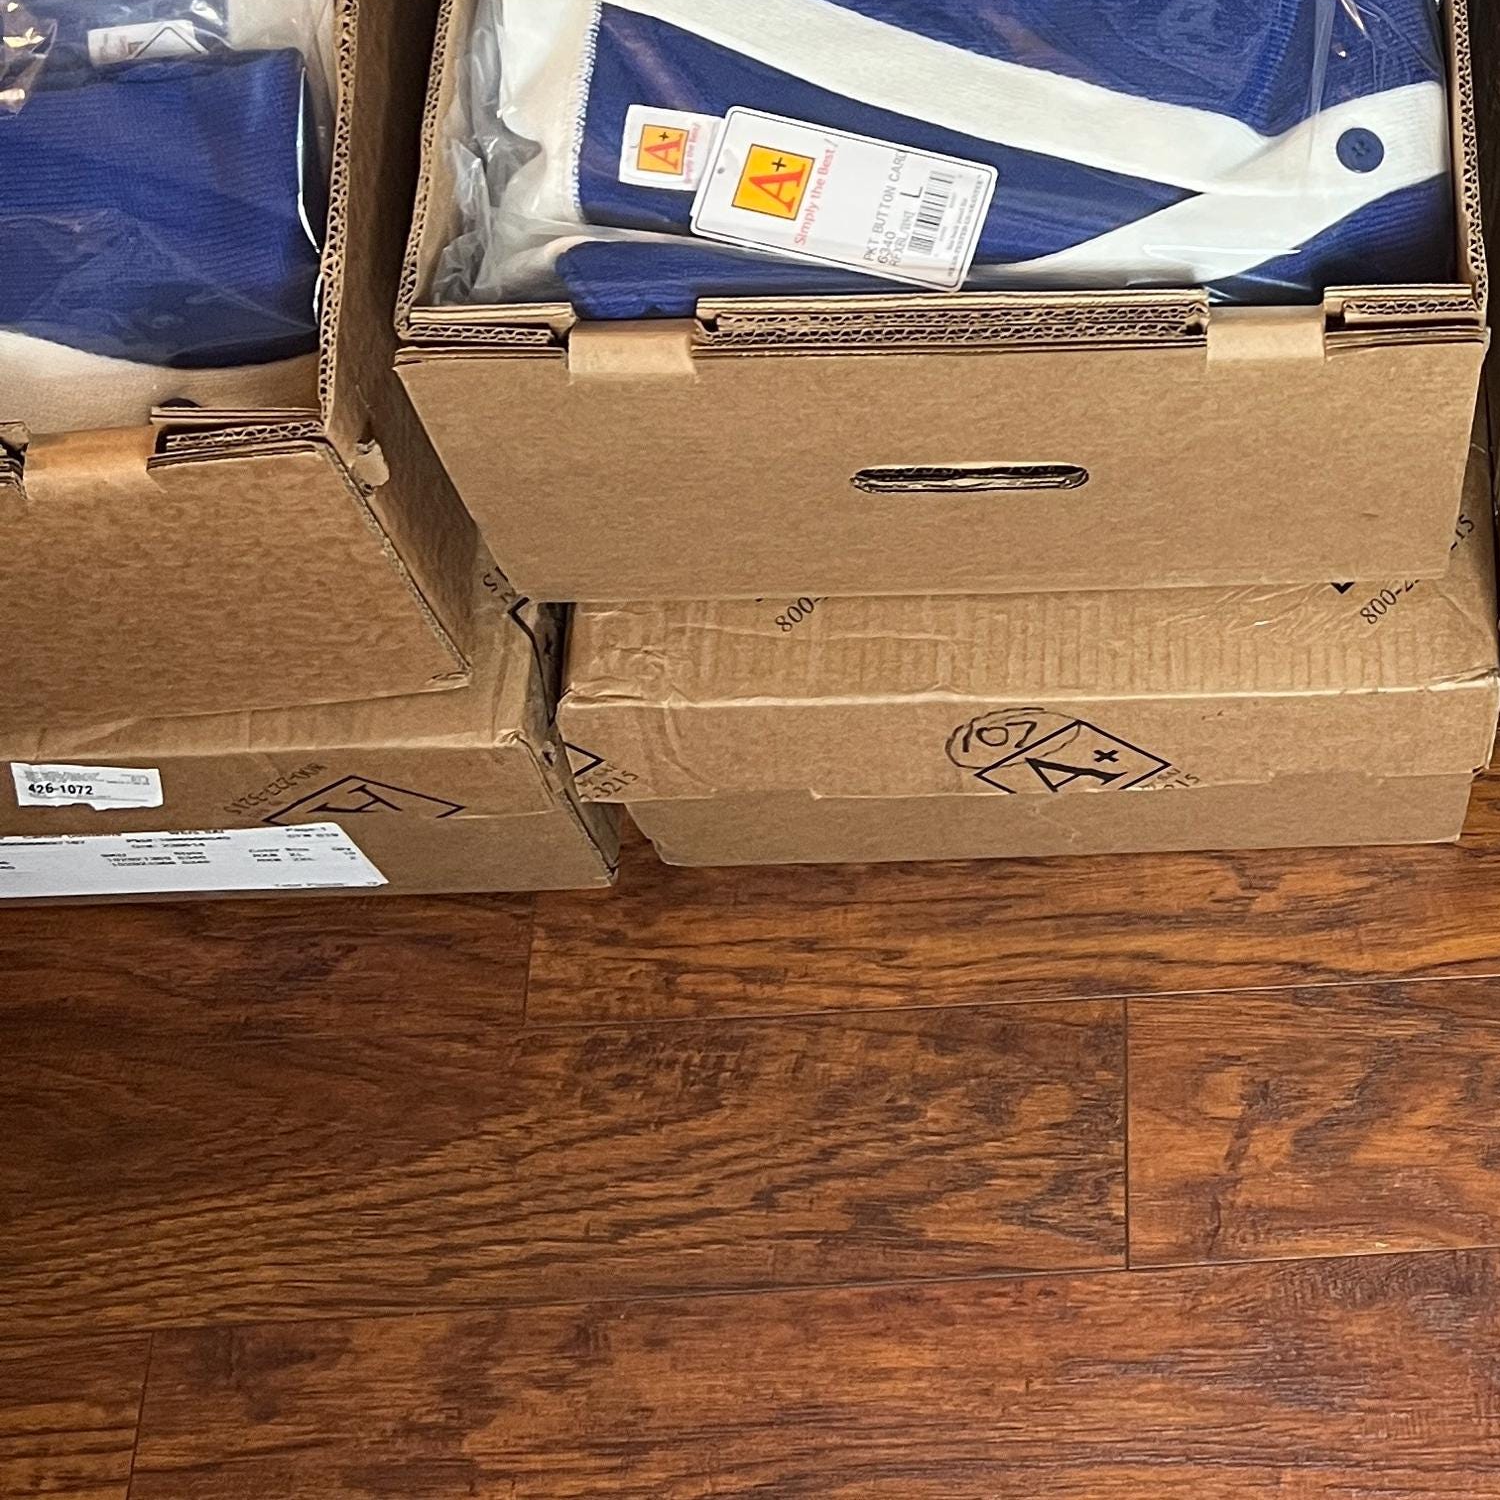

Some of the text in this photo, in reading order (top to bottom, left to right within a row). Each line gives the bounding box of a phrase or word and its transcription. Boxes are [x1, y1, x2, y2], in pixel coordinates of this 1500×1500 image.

[643, 131, 684, 170] A+
[748, 156, 807, 214] A+
[899, 181, 923, 199] L
[794, 206, 820, 246] Simply
[812, 179, 827, 203] the
[863, 237, 879, 261] PKT
[872, 184, 896, 234] BUTTON
[877, 229, 895, 264] 6340
[28, 782, 94, 797] 426-1072
